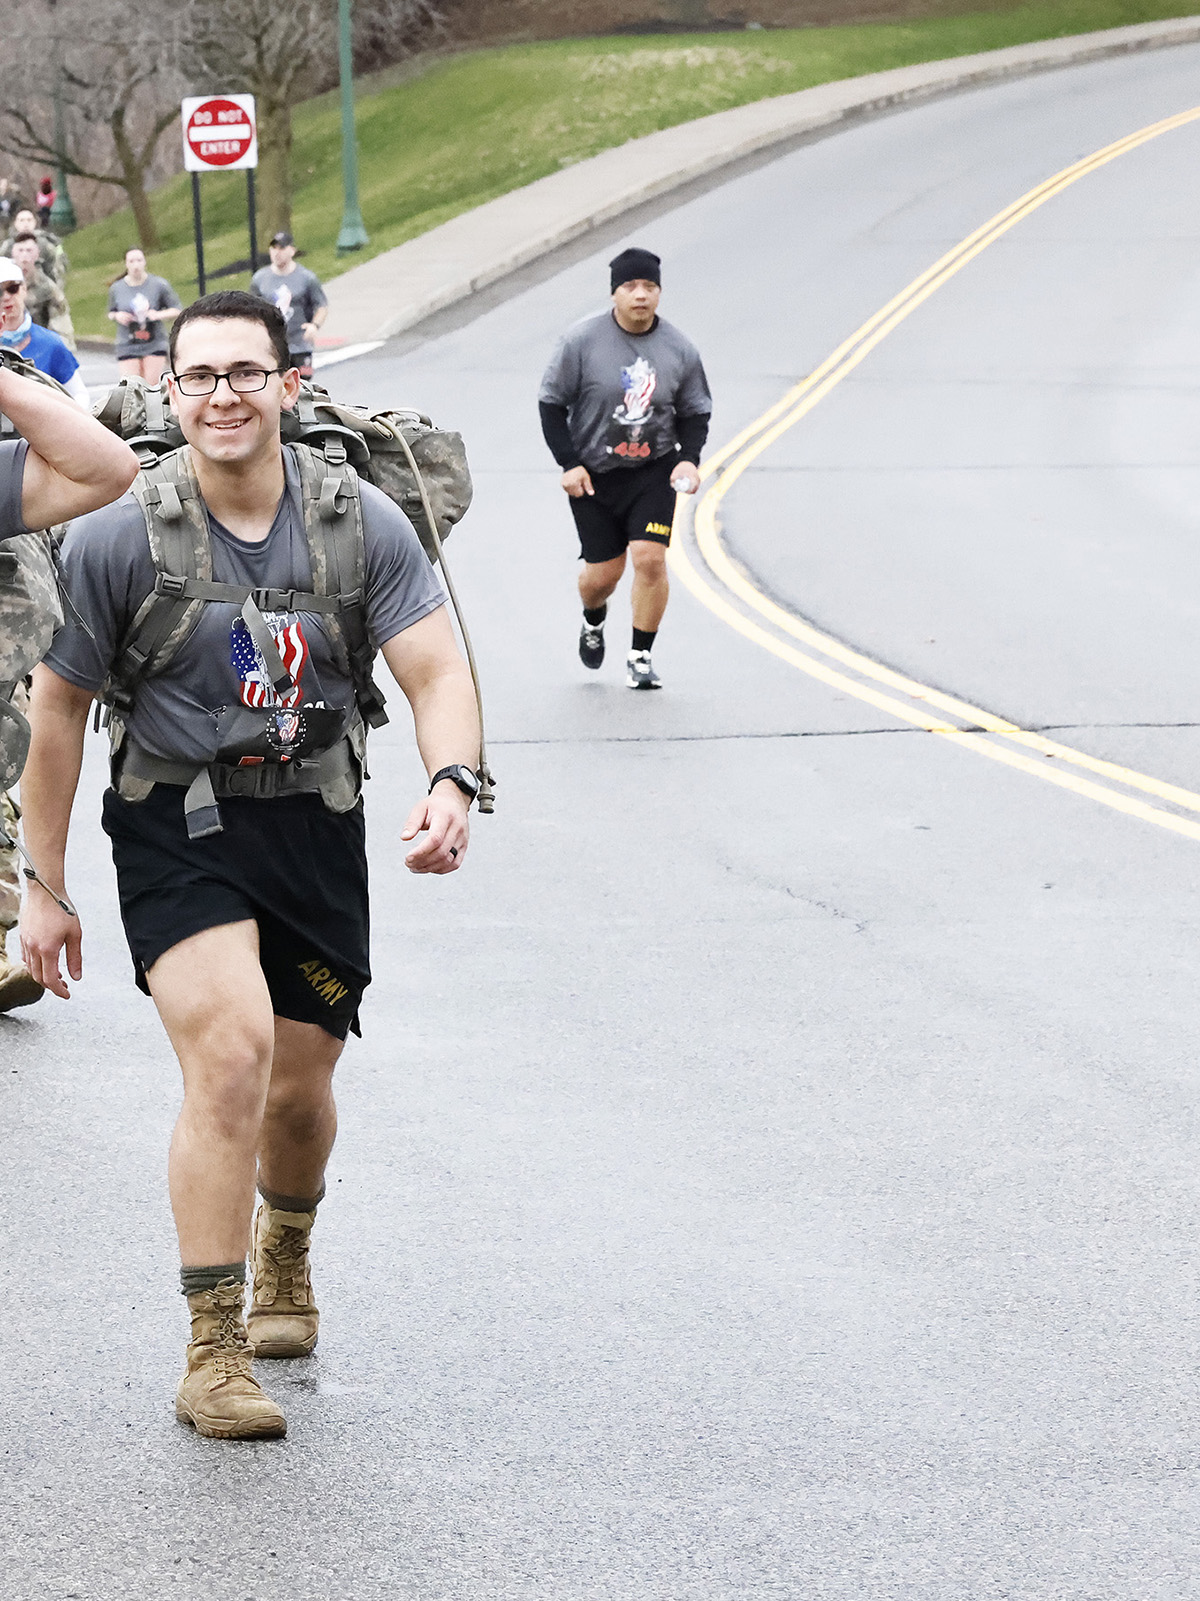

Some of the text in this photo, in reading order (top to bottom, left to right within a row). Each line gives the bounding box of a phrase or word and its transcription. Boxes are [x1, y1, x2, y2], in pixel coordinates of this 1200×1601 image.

[193, 109, 243, 125] DO NOT
[200, 140, 241, 156] ENTER
[297, 960, 349, 1007] ARMY
